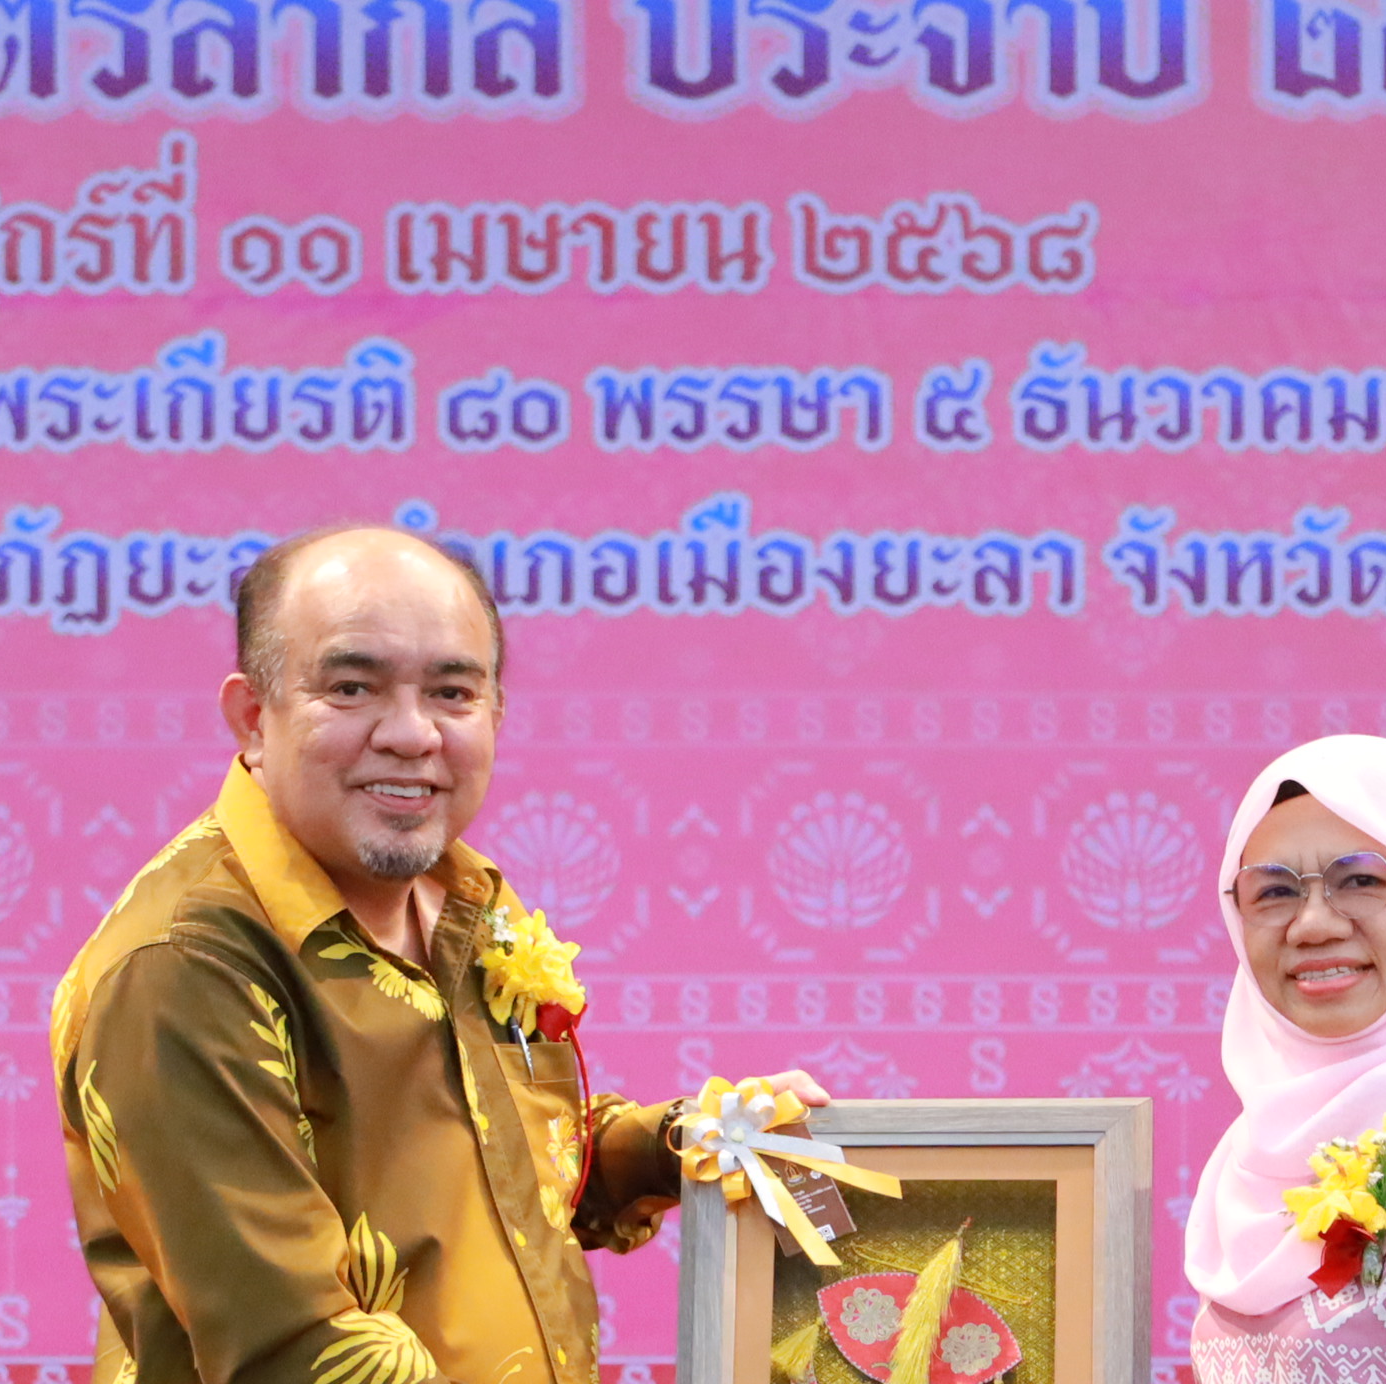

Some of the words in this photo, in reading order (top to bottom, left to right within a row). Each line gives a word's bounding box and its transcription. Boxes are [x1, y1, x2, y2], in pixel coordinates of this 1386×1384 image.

[228, 223, 354, 284] ๑๑
[395, 209, 762, 285] เมษายน
[797, 202, 1093, 285] ๒๕๖๘
[445, 373, 564, 444] ๘๐
[595, 373, 884, 444] พรรษา
[923, 364, 986, 444] ๕
[1018, 350, 1383, 444] ธันวาคม
